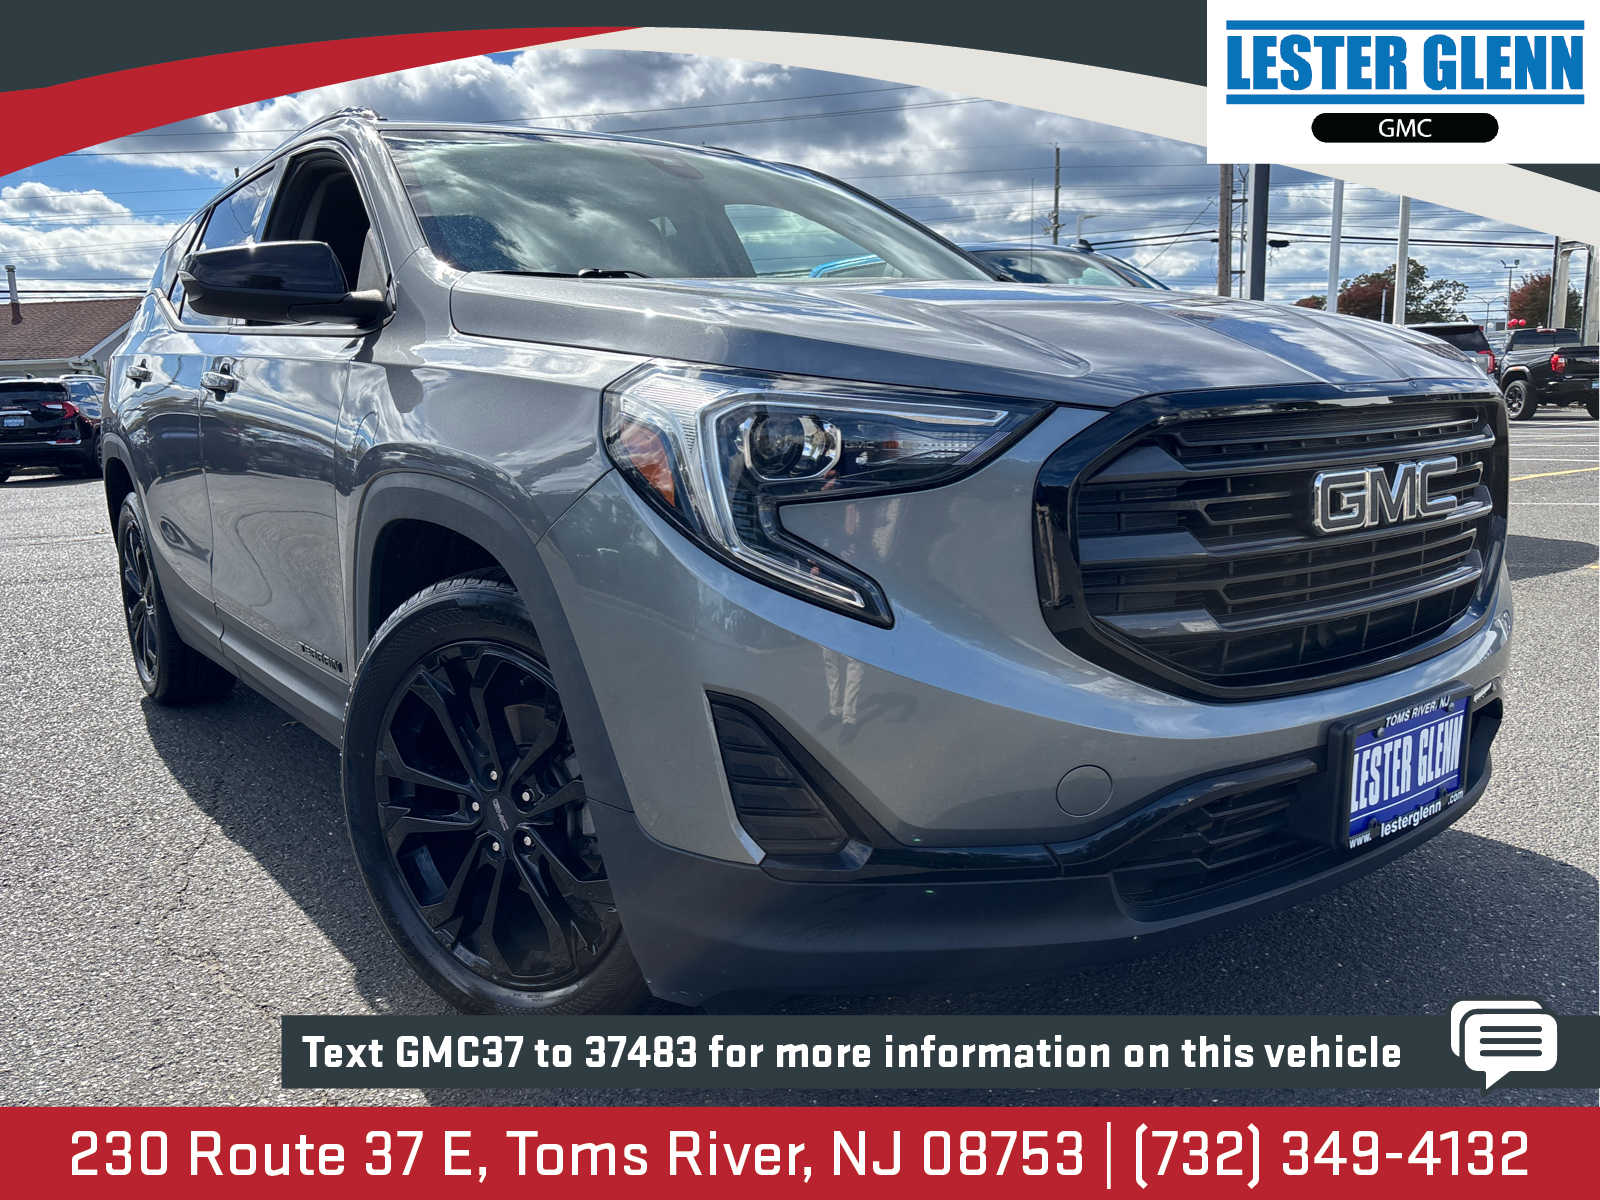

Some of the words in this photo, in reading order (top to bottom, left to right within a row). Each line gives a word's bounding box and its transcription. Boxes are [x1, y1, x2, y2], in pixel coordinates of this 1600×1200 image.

[1313, 456, 1458, 533] GMC
[1385, 709, 1411, 728] TOMS
[1411, 700, 1438, 720] RIVER,
[1438, 695, 1450, 709] NJ
[1350, 735, 1413, 814] LESTER
[1417, 715, 1464, 787] GLENN
